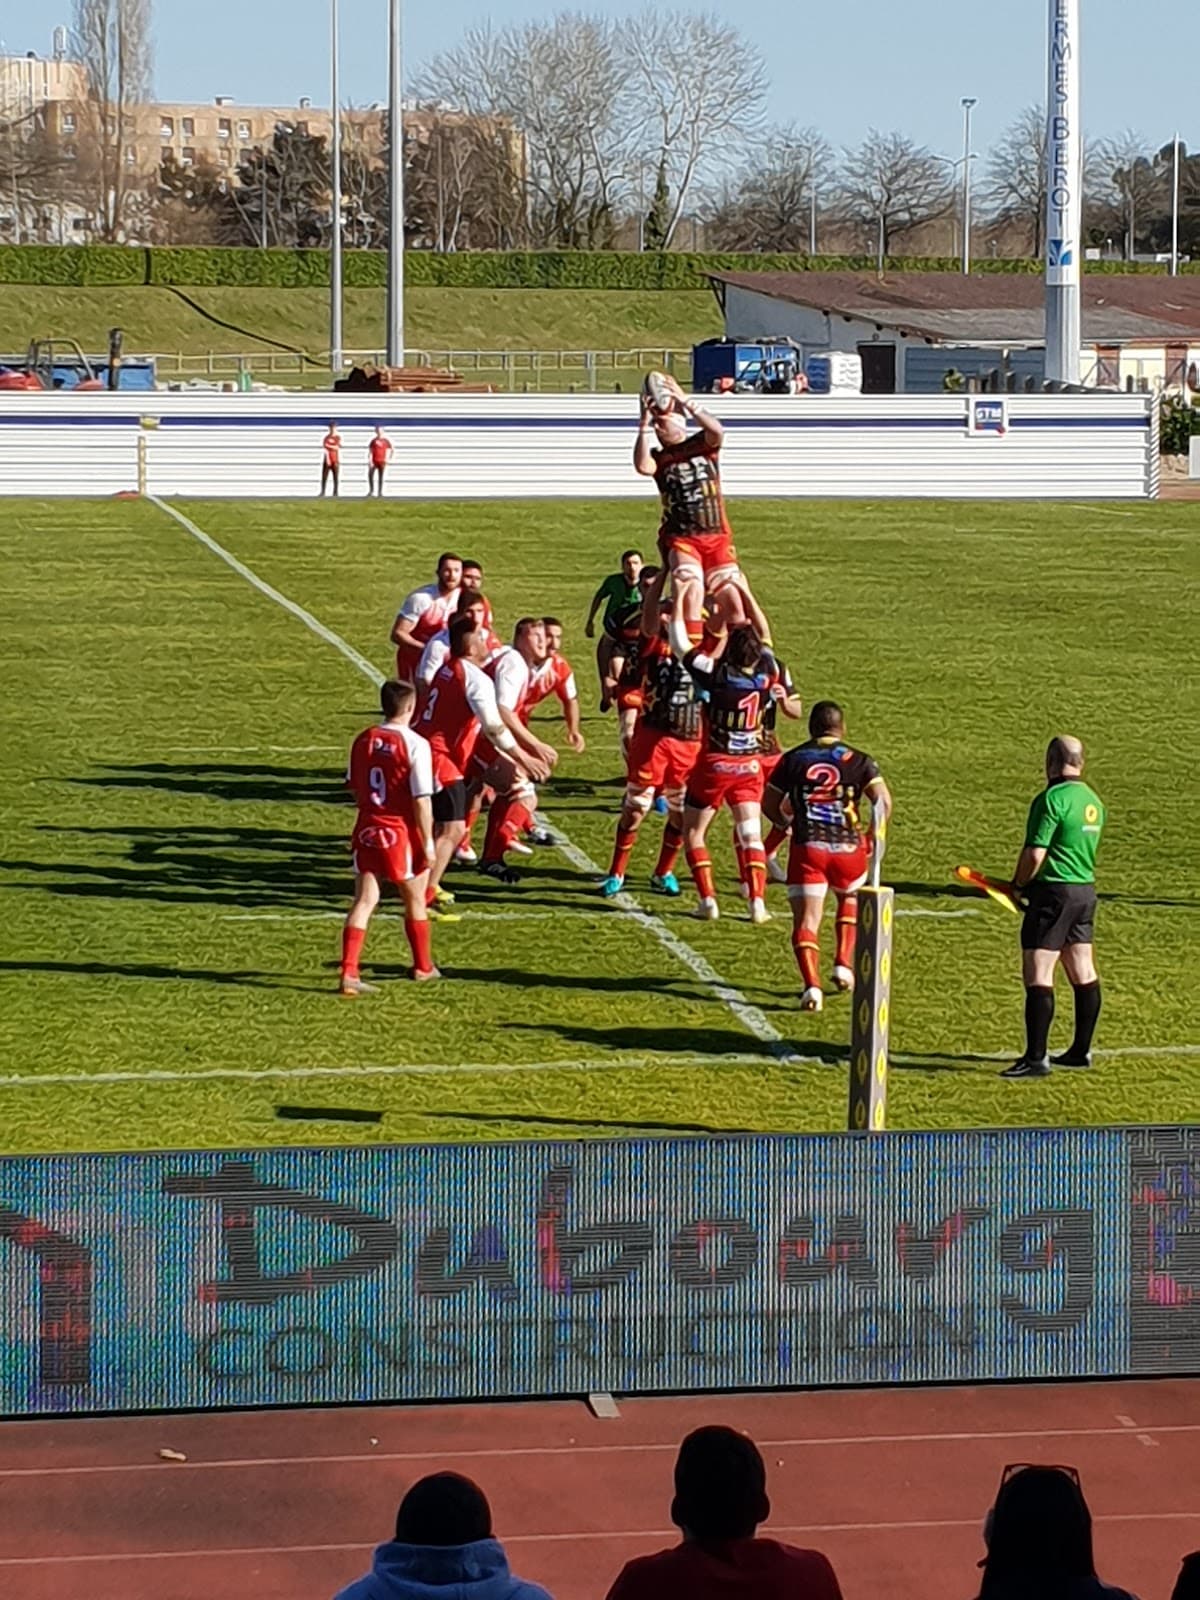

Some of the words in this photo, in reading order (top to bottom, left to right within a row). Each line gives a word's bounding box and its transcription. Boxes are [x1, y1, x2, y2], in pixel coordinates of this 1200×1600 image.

[1052, 116, 1070, 227] BEROT
[738, 690, 760, 730] 1
[370, 767, 386, 805] 9
[806, 762, 841, 803] 2
[162, 1161, 1095, 1332] Dubourg
[202, 1303, 977, 1382] CONSTRUCTION
